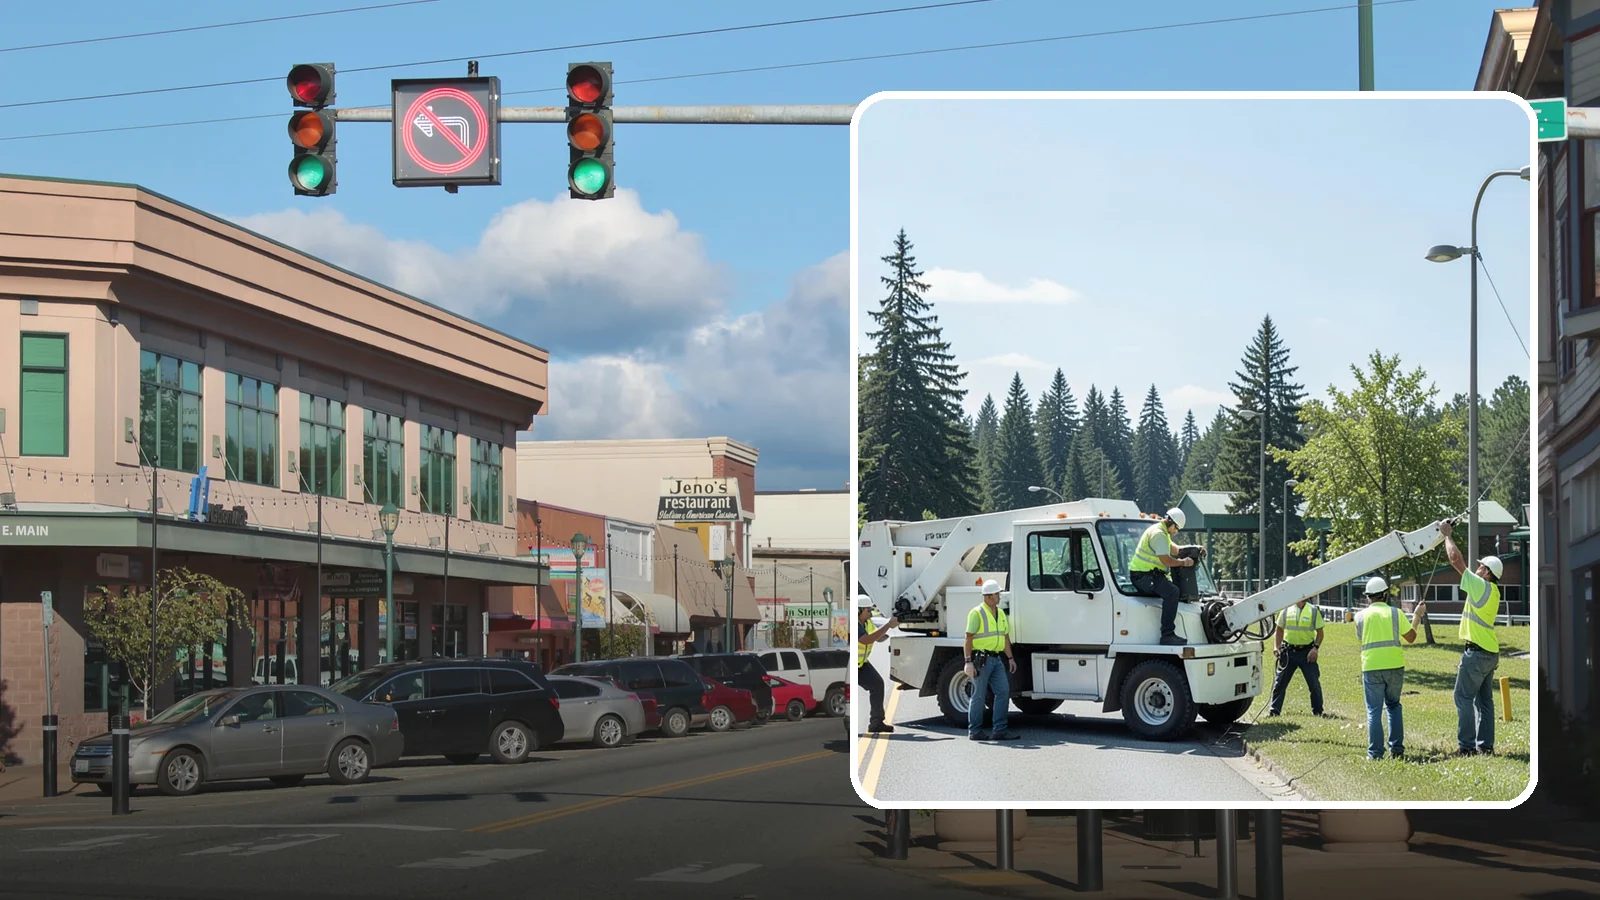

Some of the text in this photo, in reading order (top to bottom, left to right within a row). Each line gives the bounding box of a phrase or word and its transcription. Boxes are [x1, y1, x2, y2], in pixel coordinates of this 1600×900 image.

[669, 480, 728, 494] Jeno's
[665, 496, 731, 509] restaurant
[658, 510, 682, 520] Italian
[686, 510, 714, 520] American
[714, 509, 738, 519] Cuisine
[2, 525, 49, 536] E. MAIN
[797, 607, 828, 617] Street
